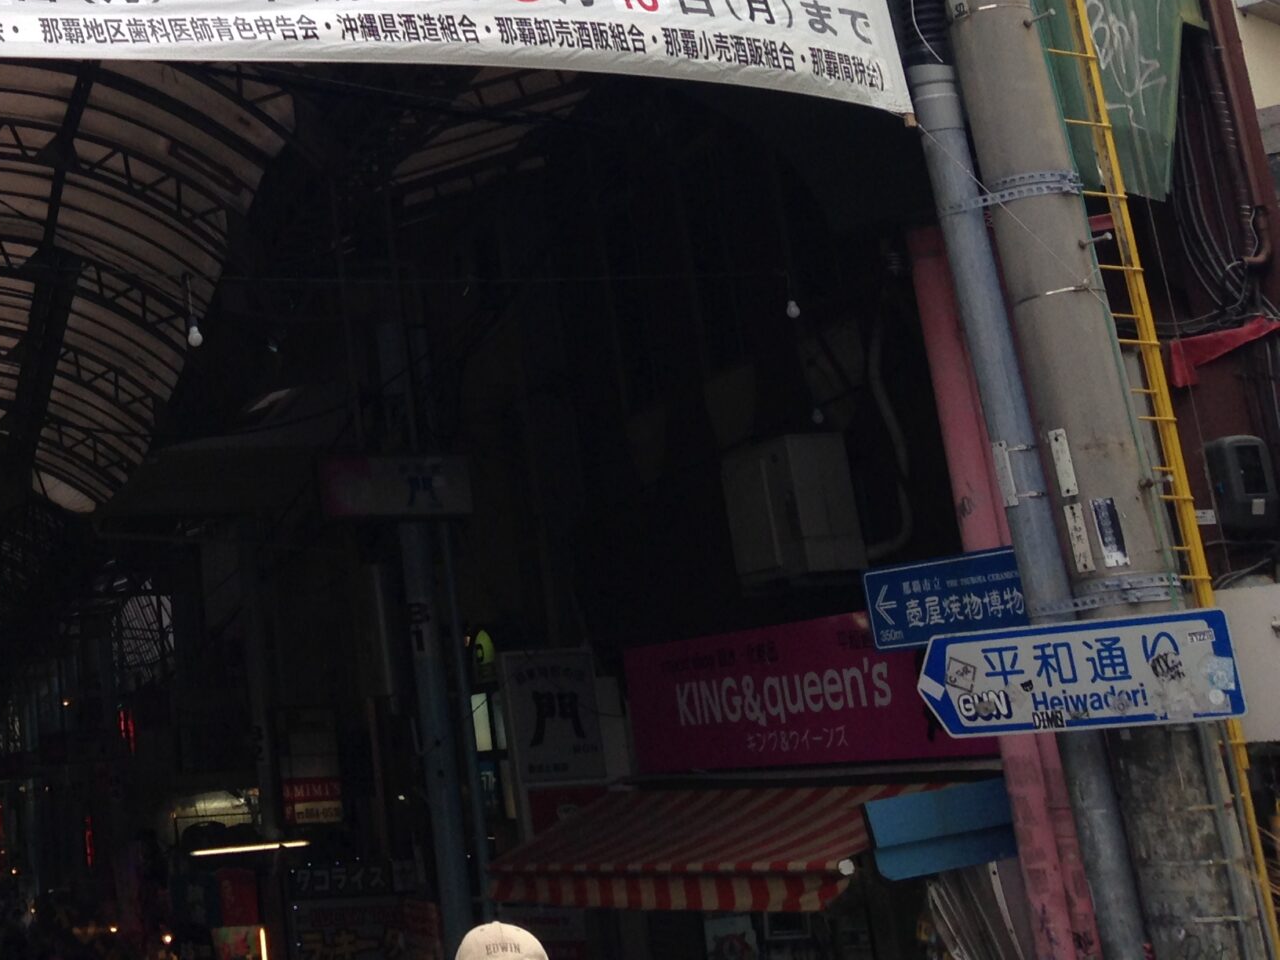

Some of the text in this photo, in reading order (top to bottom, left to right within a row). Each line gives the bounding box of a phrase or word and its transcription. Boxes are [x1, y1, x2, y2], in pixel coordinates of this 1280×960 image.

[675, 657, 893, 727] KING&queen's
[296, 866, 387, 891] タコライス
[485, 942, 521, 956] EDWIN
